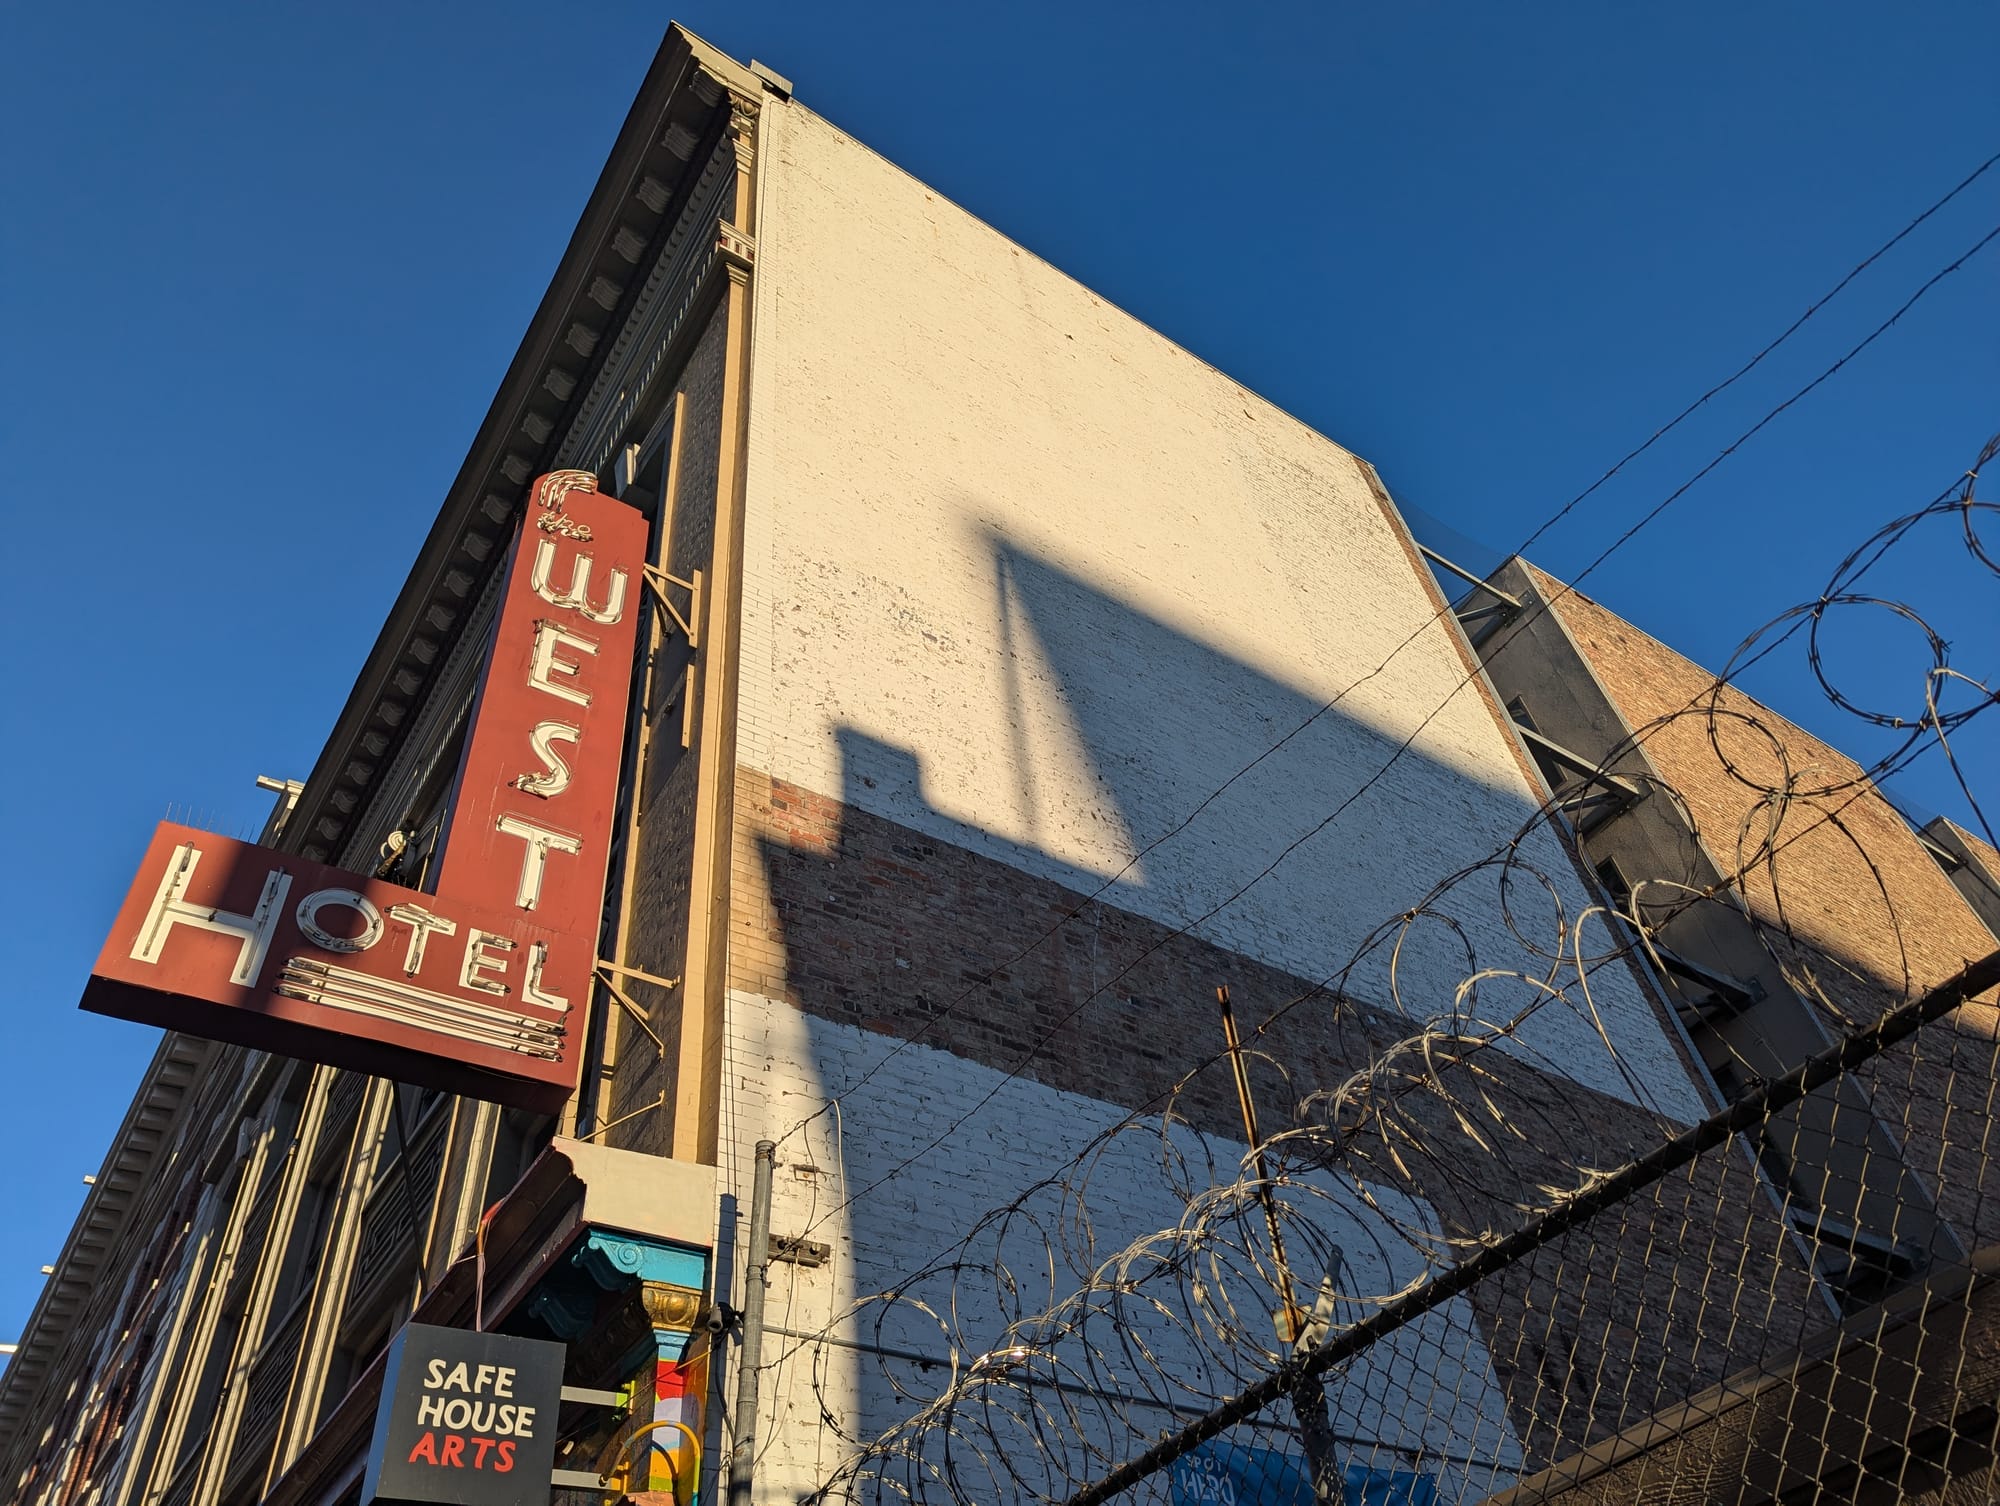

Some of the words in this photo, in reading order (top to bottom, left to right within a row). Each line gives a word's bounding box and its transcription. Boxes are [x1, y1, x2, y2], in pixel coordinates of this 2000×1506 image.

[496, 538, 629, 912] WEST
[129, 842, 571, 1012] HOTEL
[423, 1358, 517, 1398] SAFE
[417, 1396, 536, 1438] HOUSE
[408, 1432, 517, 1473] ARTS
[1185, 1455, 1222, 1472] SPOT
